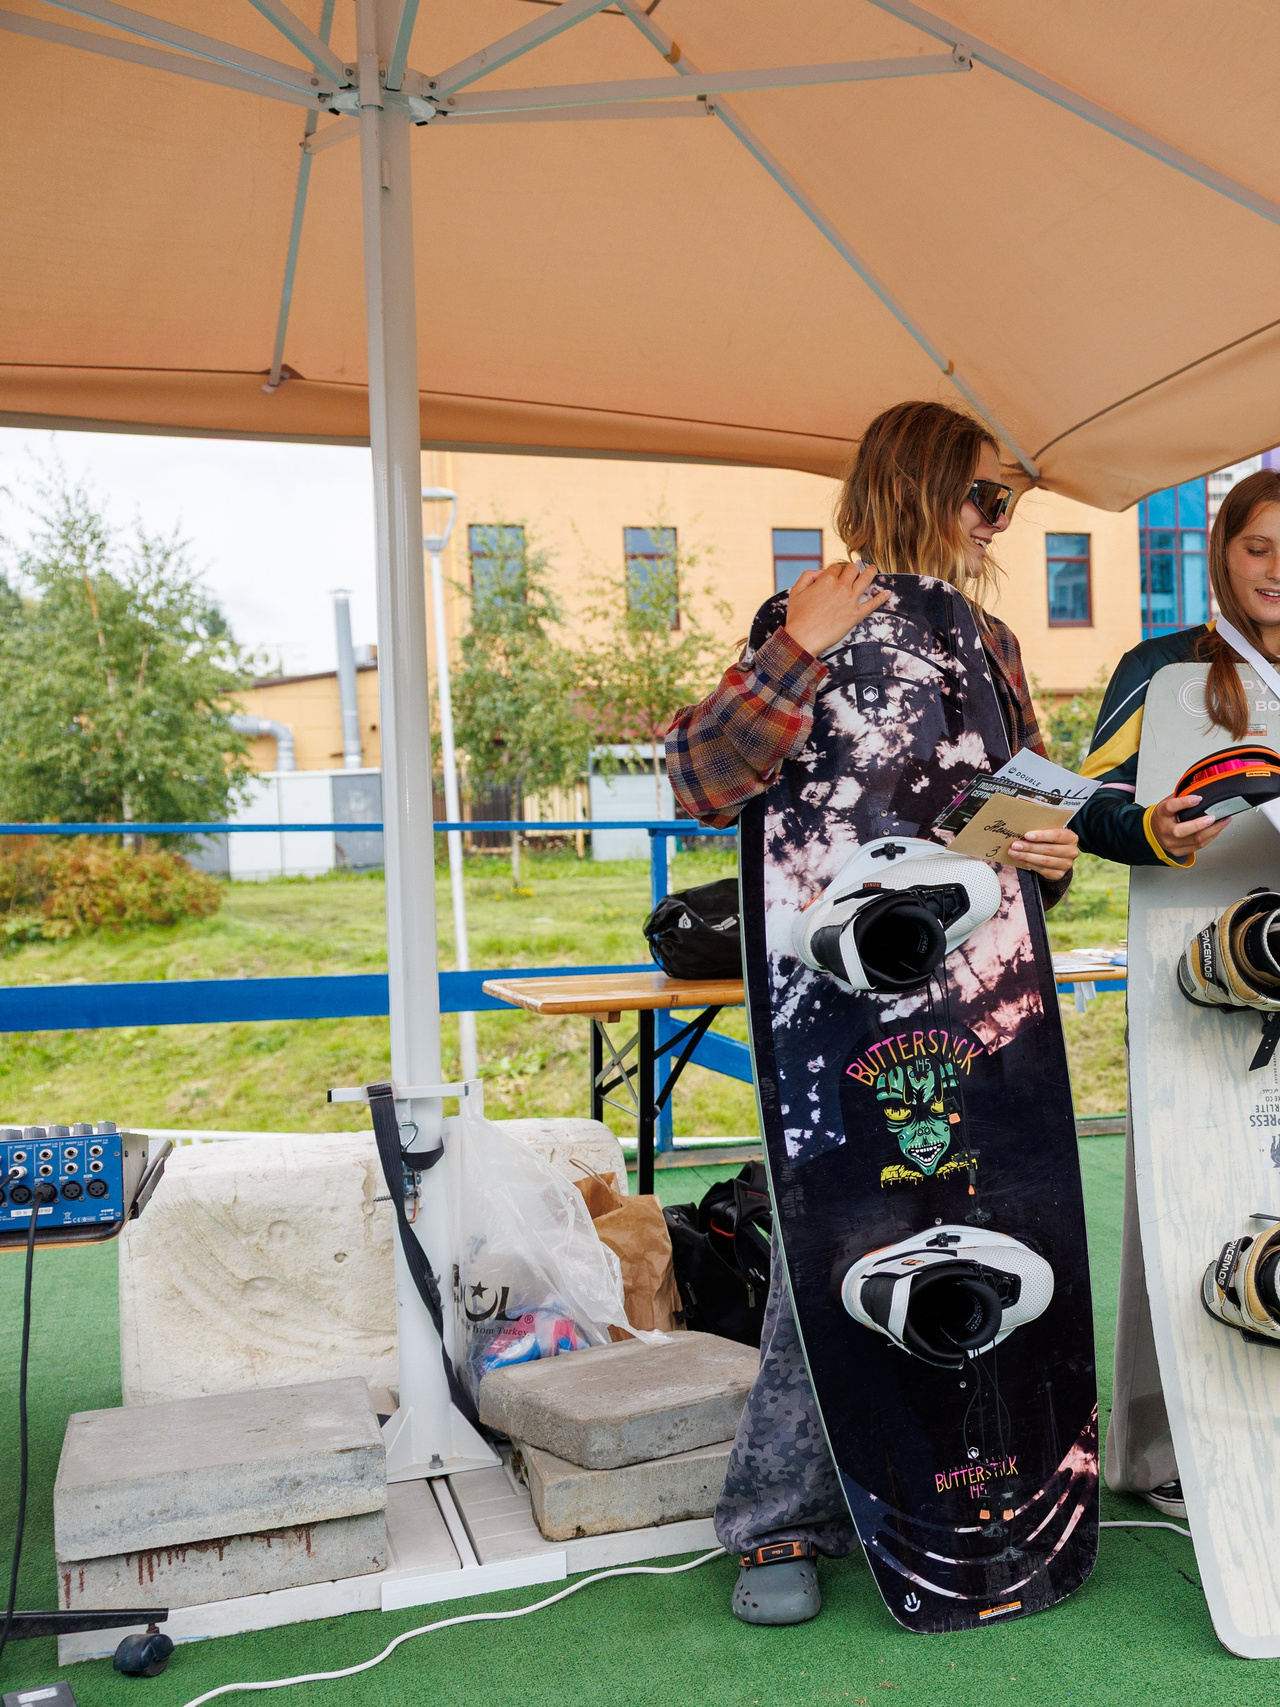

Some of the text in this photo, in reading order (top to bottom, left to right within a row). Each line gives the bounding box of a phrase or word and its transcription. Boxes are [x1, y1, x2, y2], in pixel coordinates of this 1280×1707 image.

[1015, 769, 1042, 787] DOUBLE
[846, 1029, 984, 1086] BUTTERSTICK
[915, 1058, 932, 1072] 145
[472, 1324, 494, 1335] from
